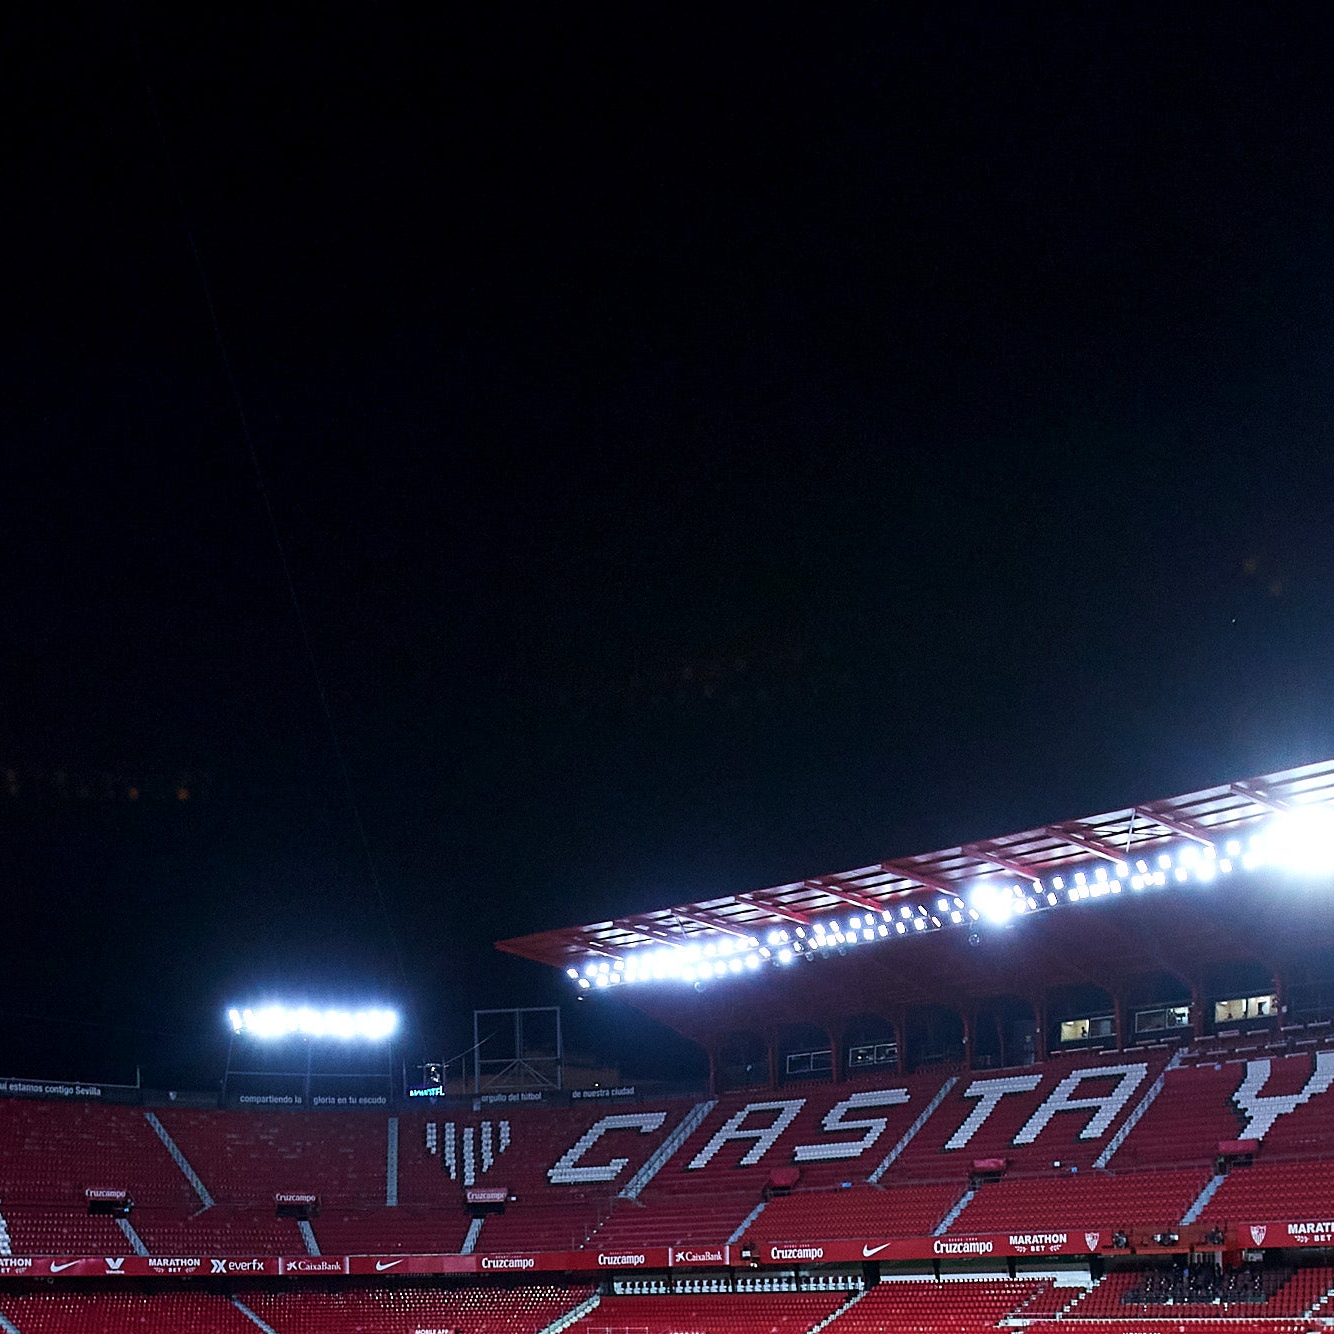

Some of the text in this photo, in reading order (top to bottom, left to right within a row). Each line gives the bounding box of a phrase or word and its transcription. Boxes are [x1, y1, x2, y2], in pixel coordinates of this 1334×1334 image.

[9, 1083, 44, 1094] estamos
[45, 1084, 74, 1096] contigo
[75, 1084, 101, 1097] Sevilla
[240, 1093, 294, 1106] compartiendo
[313, 1095, 336, 1107] gloria
[358, 1095, 387, 1106] escudo
[547, 1062, 1149, 1184] CASTA
[85, 1188, 127, 1199] Cruzcampo
[275, 1192, 316, 1203] Cruzcampo
[1009, 1233, 1067, 1246] MARATHON
[1314, 1234, 1332, 1242] BET
[770, 1245, 824, 1260] Cruzcampo
[933, 1239, 994, 1255] Cruzcampo
[148, 1257, 201, 1268] MARATHON
[481, 1255, 535, 1270] Cruzcampo
[598, 1253, 645, 1267] Cruzcampo
[685, 1251, 723, 1263] CaixaBank
[228, 1259, 265, 1272] everfx
[298, 1260, 342, 1272] CaixaBank
